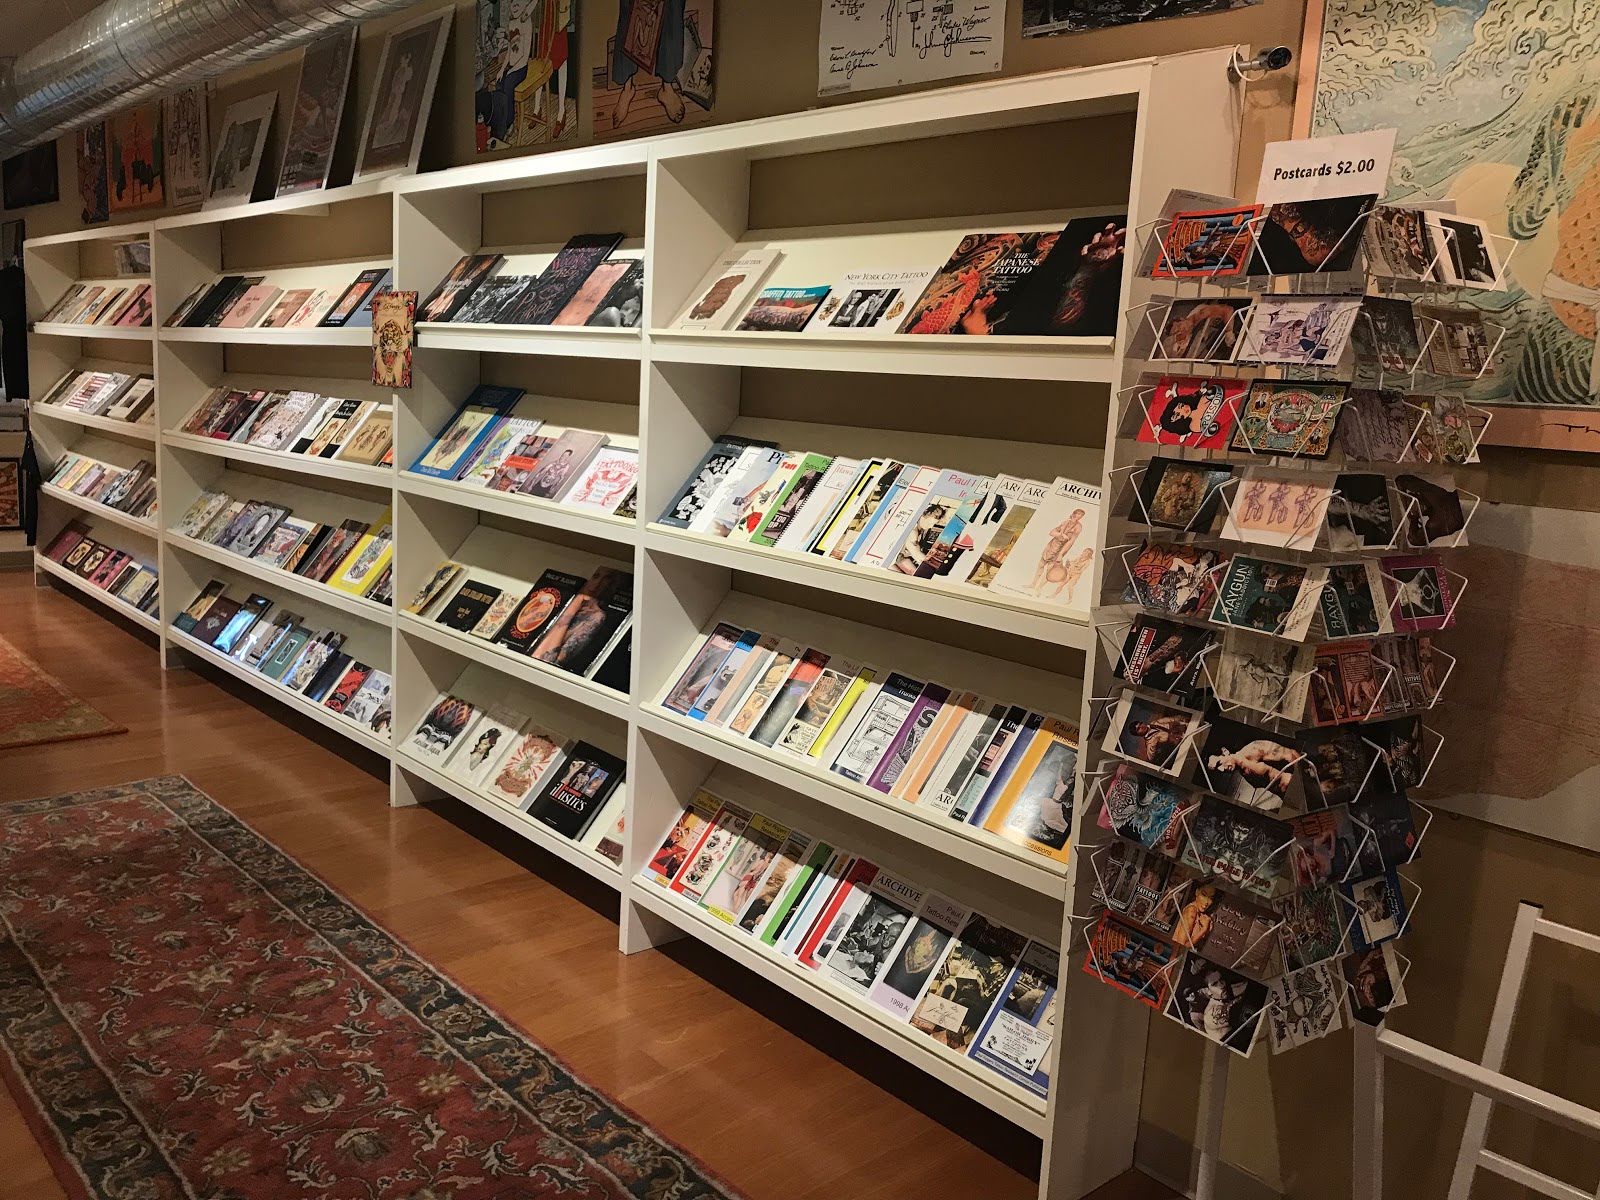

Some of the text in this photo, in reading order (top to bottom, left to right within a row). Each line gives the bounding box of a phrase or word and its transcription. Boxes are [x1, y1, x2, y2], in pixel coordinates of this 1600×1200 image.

[1273, 159, 1376, 180] Postcards $2.00
[992, 258, 1042, 267] JAPANESE
[861, 273, 881, 281] YORK
[881, 272, 900, 281] CITY
[900, 271, 929, 280] TATTOO
[992, 266, 1033, 274] TATTOO
[1202, 391, 1223, 425] POISON
[947, 474, 971, 486] Paul
[896, 680, 908, 689] The
[1054, 721, 1073, 733] Paul
[877, 875, 923, 901] ARCHIVE
[926, 906, 945, 920] Tattoo
[946, 906, 961, 919] Paul
[890, 997, 904, 1010] 1998
